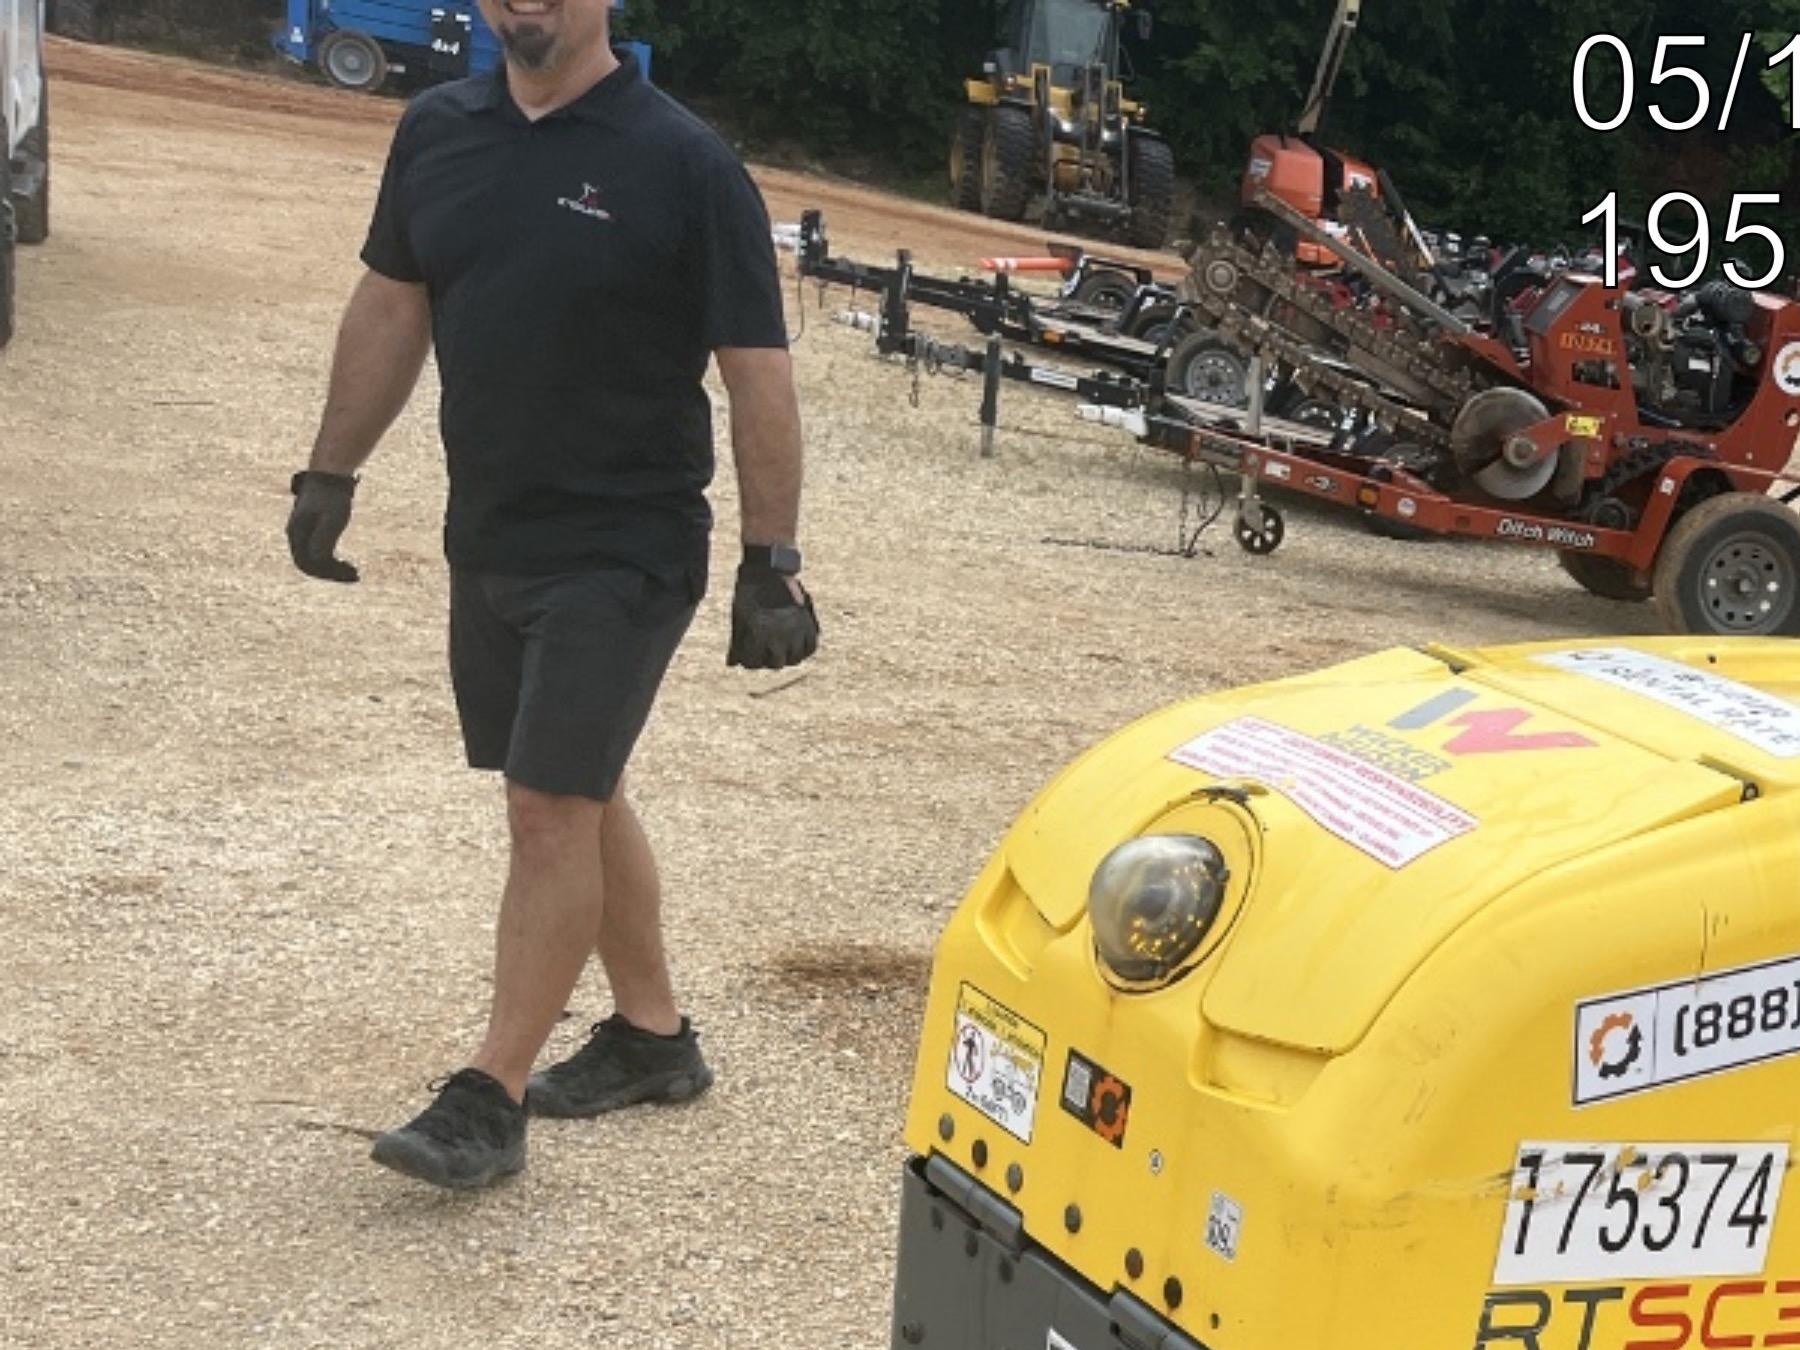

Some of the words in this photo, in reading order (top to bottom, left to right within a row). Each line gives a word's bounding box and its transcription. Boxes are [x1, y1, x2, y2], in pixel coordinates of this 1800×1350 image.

[1497, 517, 1543, 540] Ditch
[1547, 526, 1595, 548] Witch
[1514, 1150, 1775, 1257] 175374
